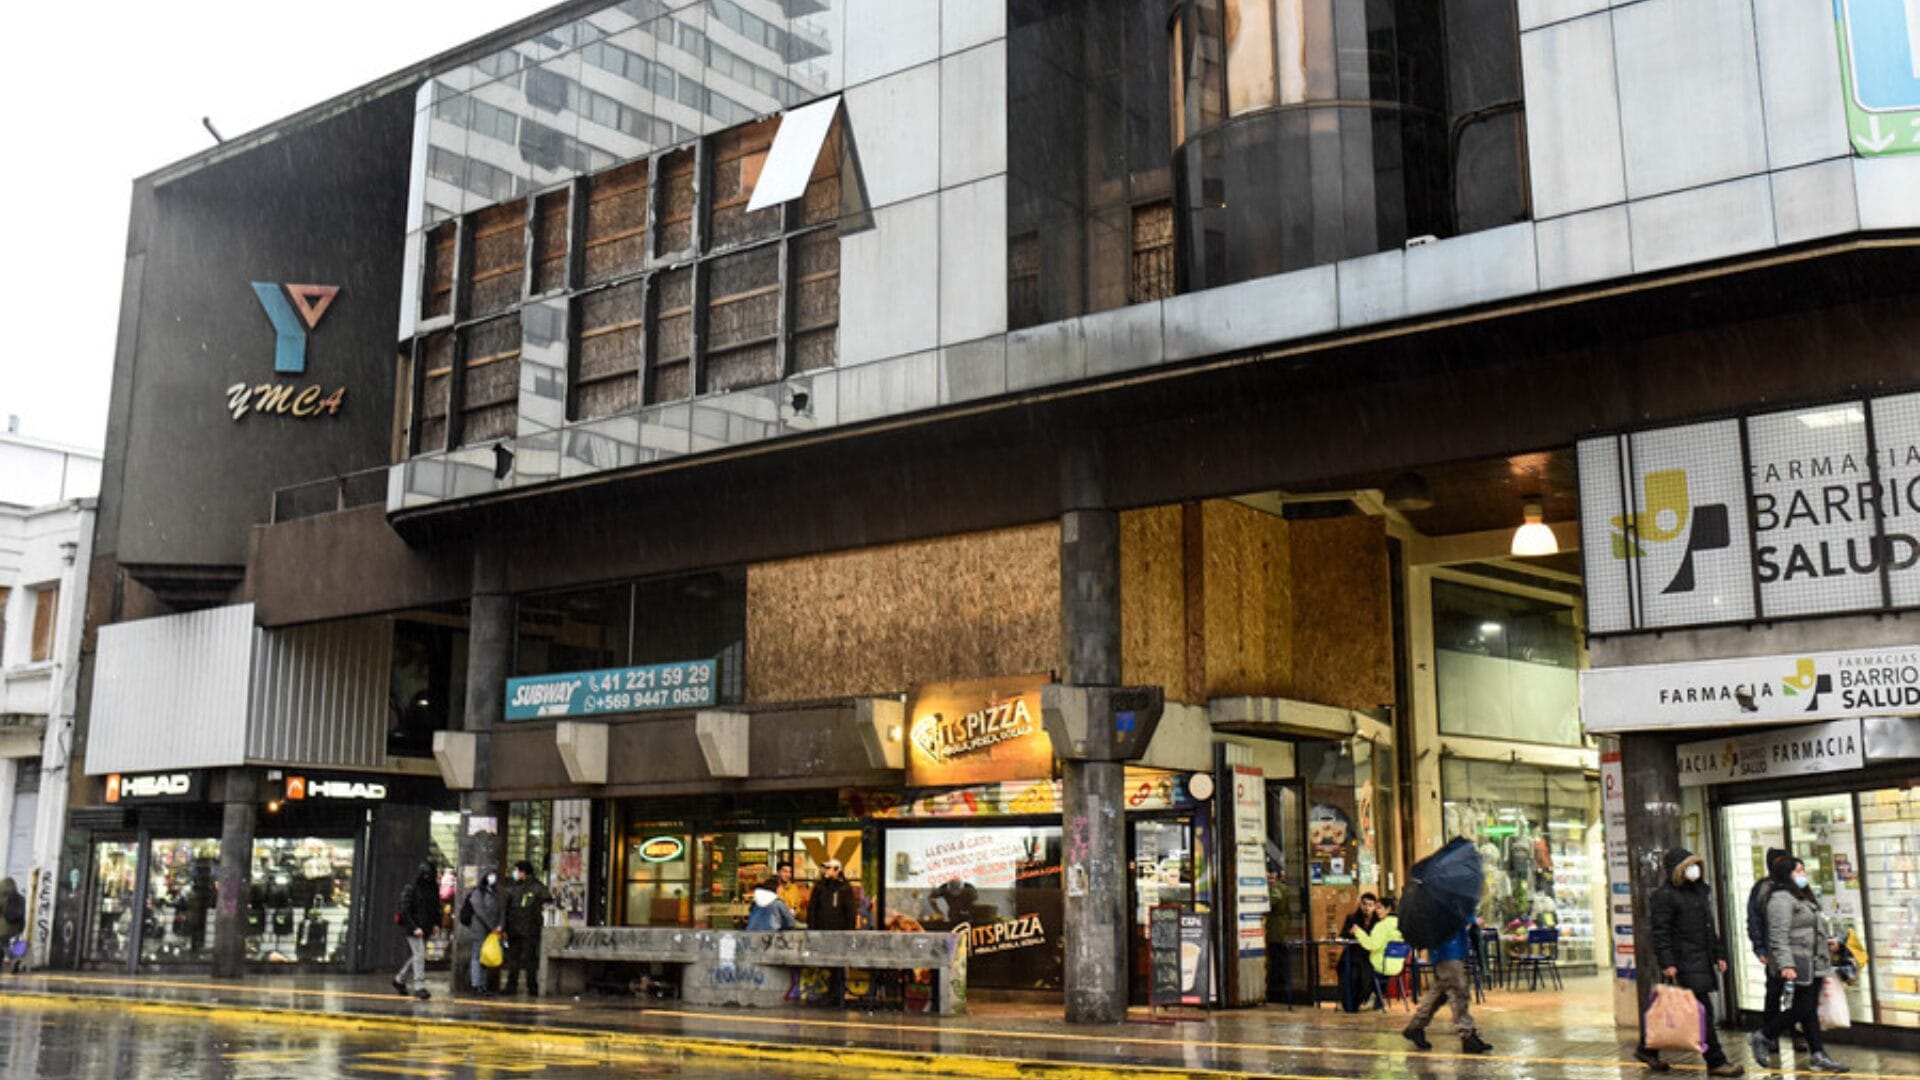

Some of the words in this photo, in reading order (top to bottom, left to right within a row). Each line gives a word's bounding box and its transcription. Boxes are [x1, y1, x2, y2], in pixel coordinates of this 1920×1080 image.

[226, 382, 346, 420] YMCA
[1759, 533, 1919, 583] SALUD
[1838, 653, 1918, 667] FARMACIAS
[600, 672, 620, 691] 41
[626, 670, 655, 690] 221
[661, 667, 683, 687] 59
[688, 664, 710, 685] 29
[1840, 665, 1919, 688] BARRIO
[511, 680, 582, 707] SUBWAY
[596, 693, 629, 710] +569
[634, 690, 668, 708] 9447
[672, 686, 709, 703] 0630
[1841, 686, 1920, 710] SALUD
[1773, 735, 1856, 764] FARMACIA
[121, 774, 190, 796] HEAD
[308, 780, 387, 800] HEAD
